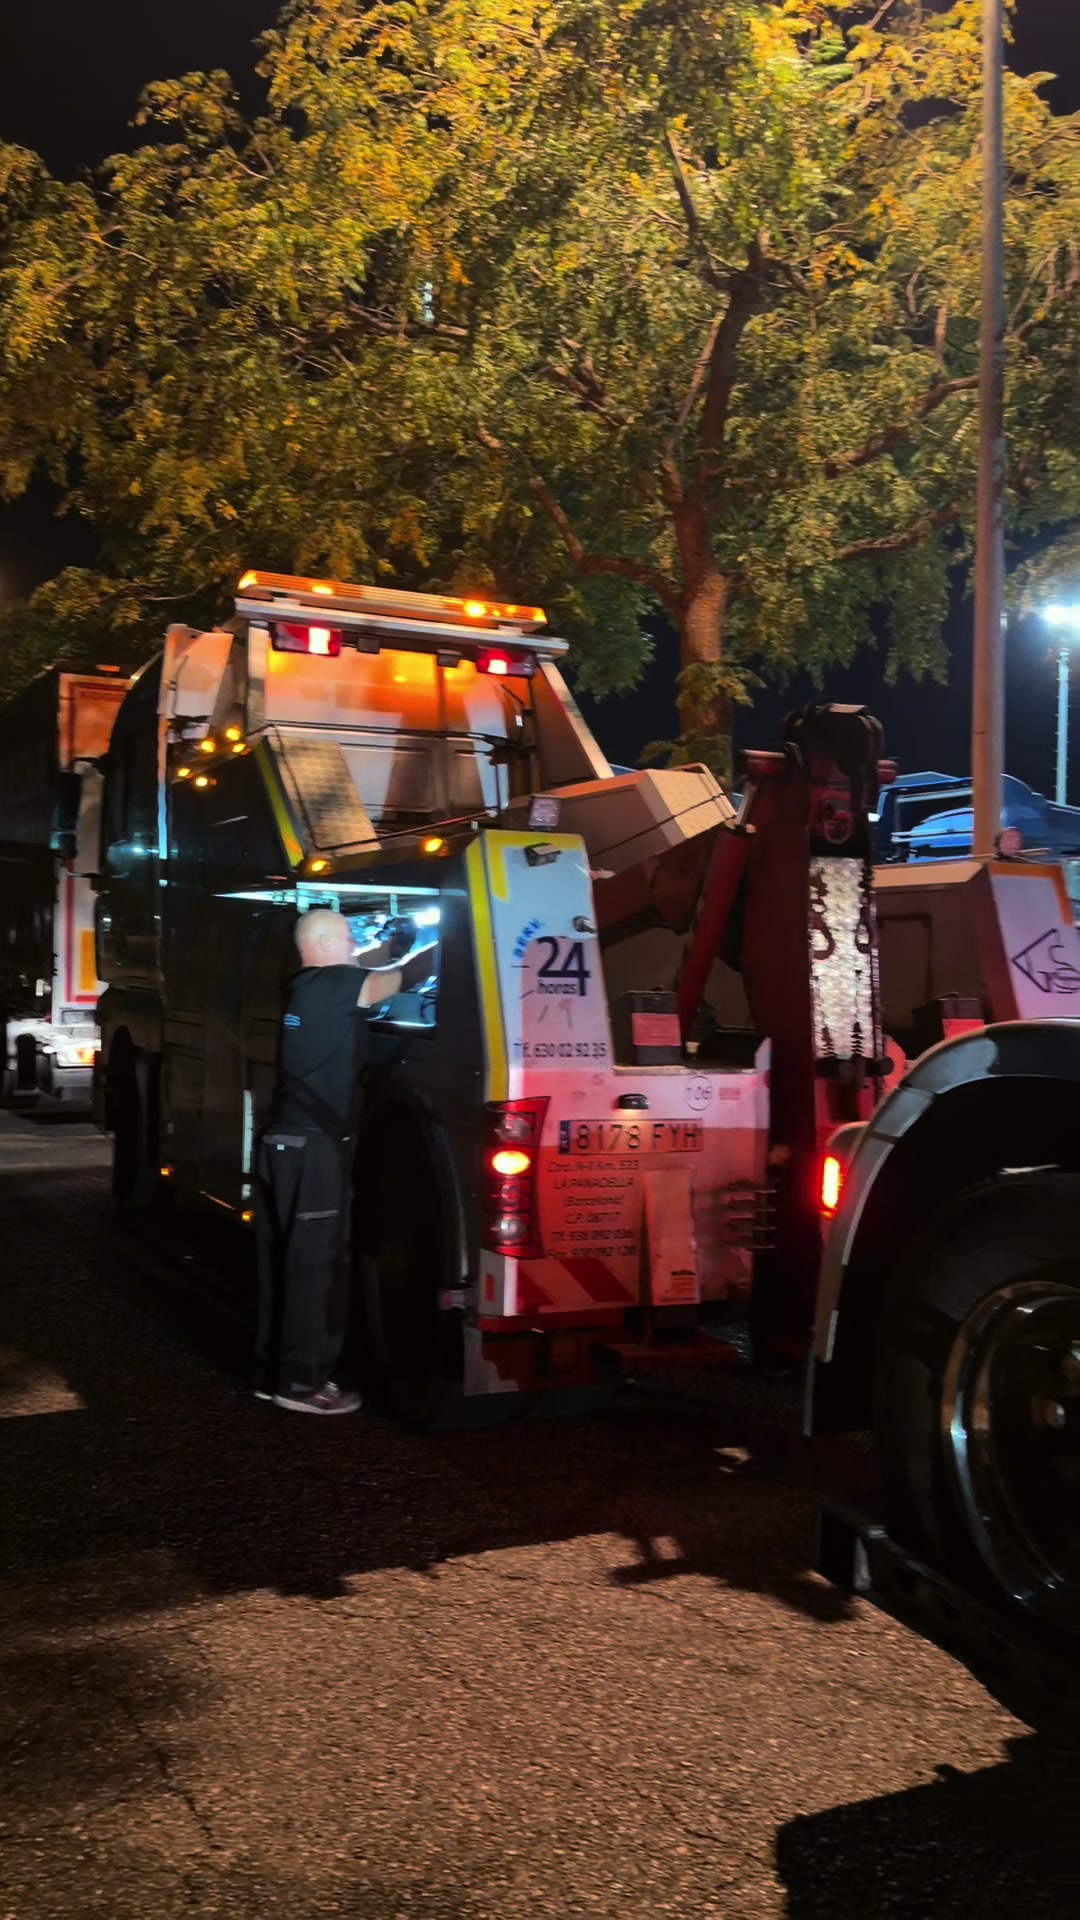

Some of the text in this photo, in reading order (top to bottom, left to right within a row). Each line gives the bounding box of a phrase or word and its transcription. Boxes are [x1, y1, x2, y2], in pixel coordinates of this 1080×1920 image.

[536, 936, 591, 997] 24
[576, 1123, 698, 1150] 8178 FYH
[554, 1176, 634, 1190] LA PANADELLA
